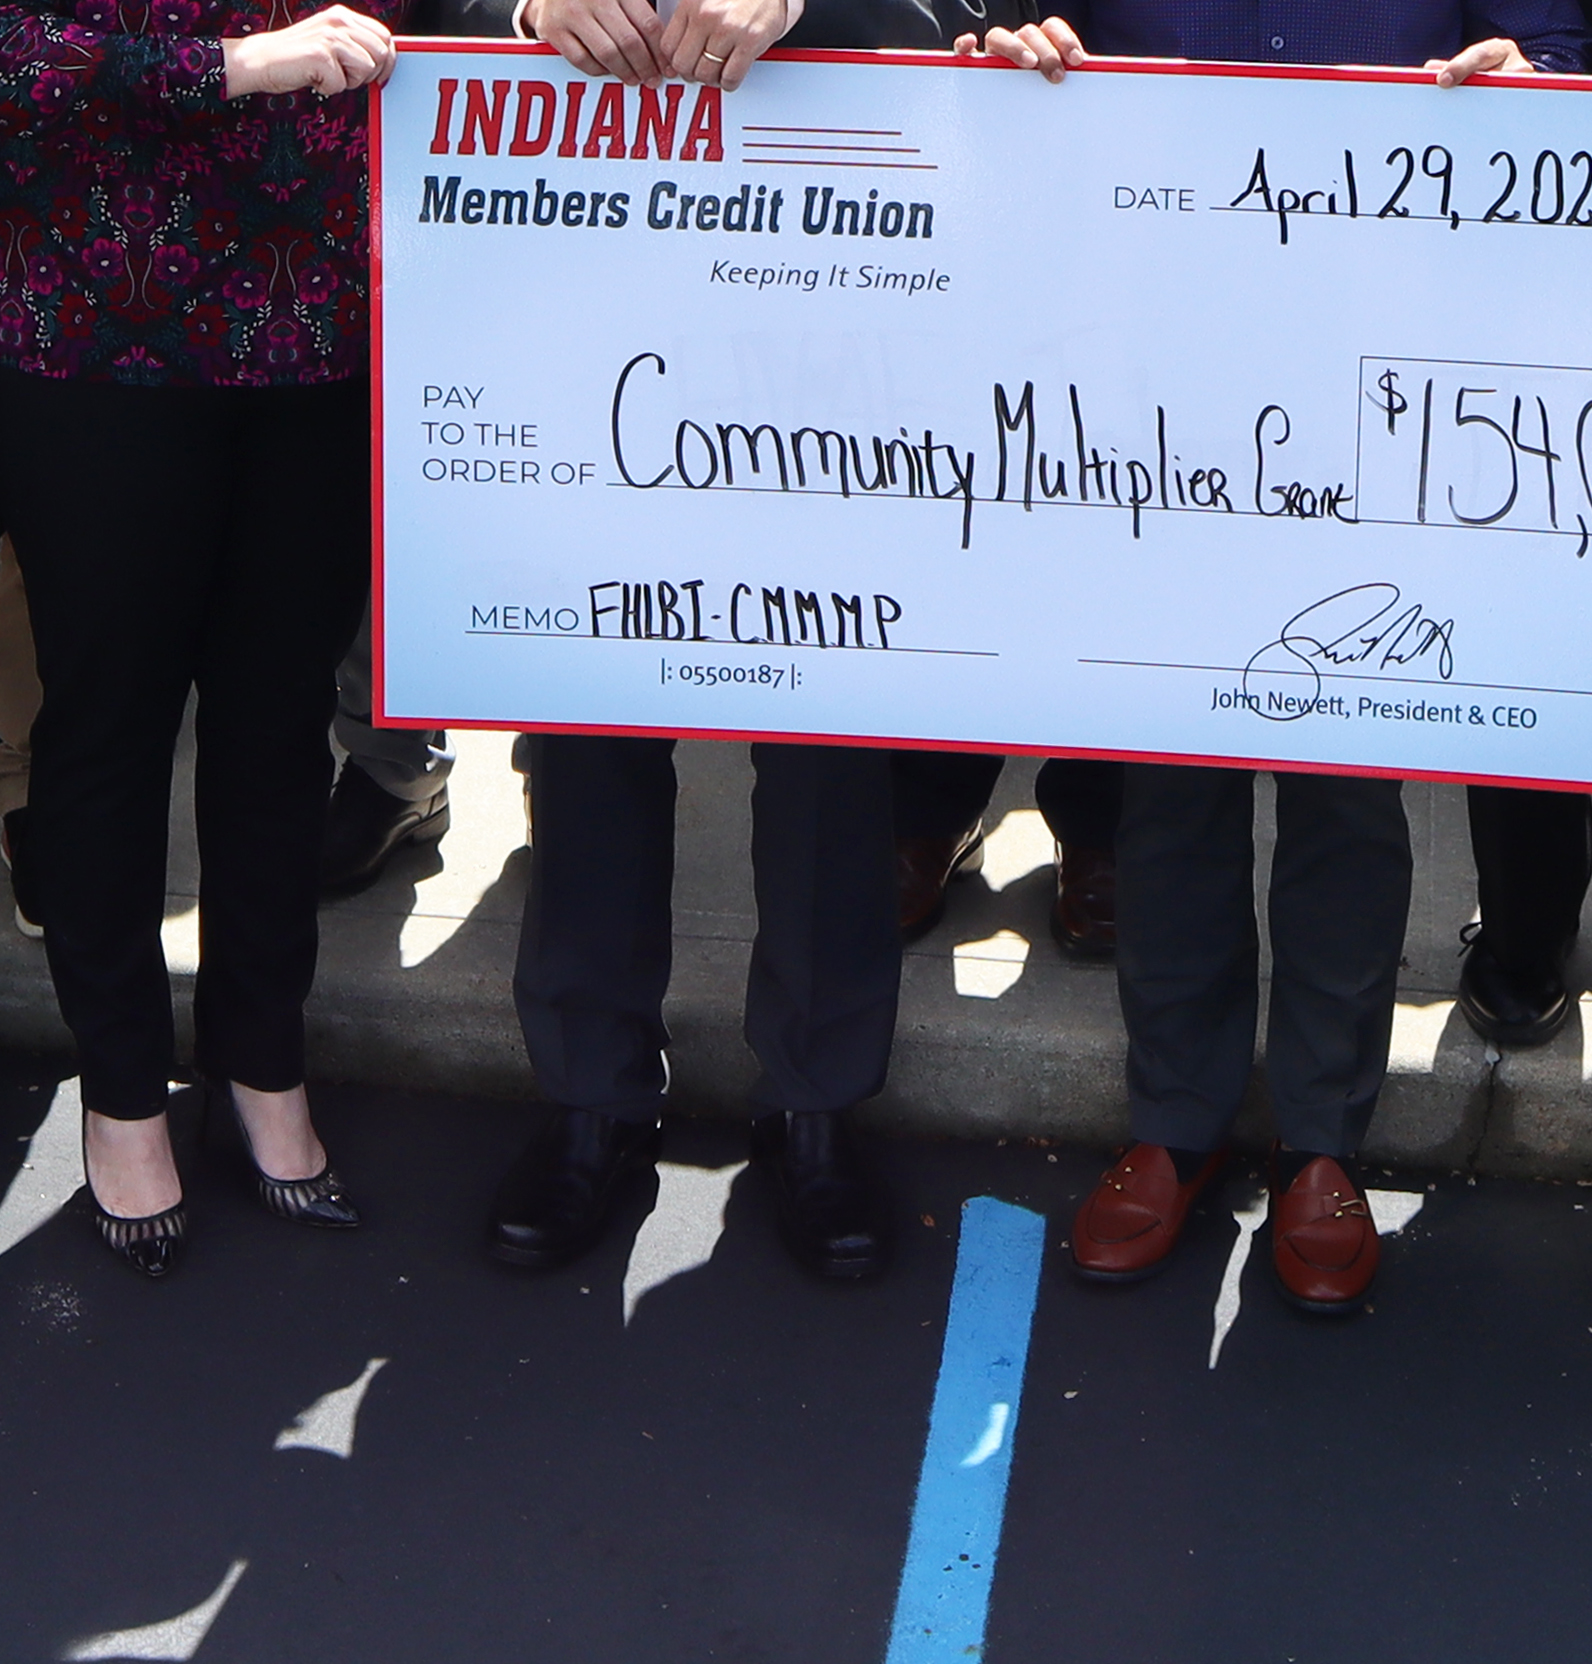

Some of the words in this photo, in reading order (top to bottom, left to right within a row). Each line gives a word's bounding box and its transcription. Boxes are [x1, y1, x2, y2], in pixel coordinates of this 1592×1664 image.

[429, 78, 725, 162] INDIANA
[419, 175, 629, 229] Members
[647, 181, 783, 233] Credit
[802, 186, 935, 239] Union
[1114, 185, 1195, 211] DATE
[1229, 148, 1359, 245] April
[1377, 145, 1461, 230] 29,
[710, 259, 819, 291] Keeping
[828, 263, 849, 288] It
[856, 264, 951, 295] Simple
[422, 385, 485, 410] PAY
[421, 422, 465, 446] TO
[475, 423, 539, 448] THE
[612, 352, 974, 549] Community
[421, 459, 542, 484] ORDER
[550, 461, 597, 486] OF
[472, 605, 579, 631] MEMO
[679, 664, 785, 688] 05500187
[1211, 688, 1259, 711] John
[1268, 690, 1350, 719] Newett,
[1359, 697, 1461, 724] President
[1468, 705, 1486, 725] &
[1492, 707, 1537, 730] CEO
